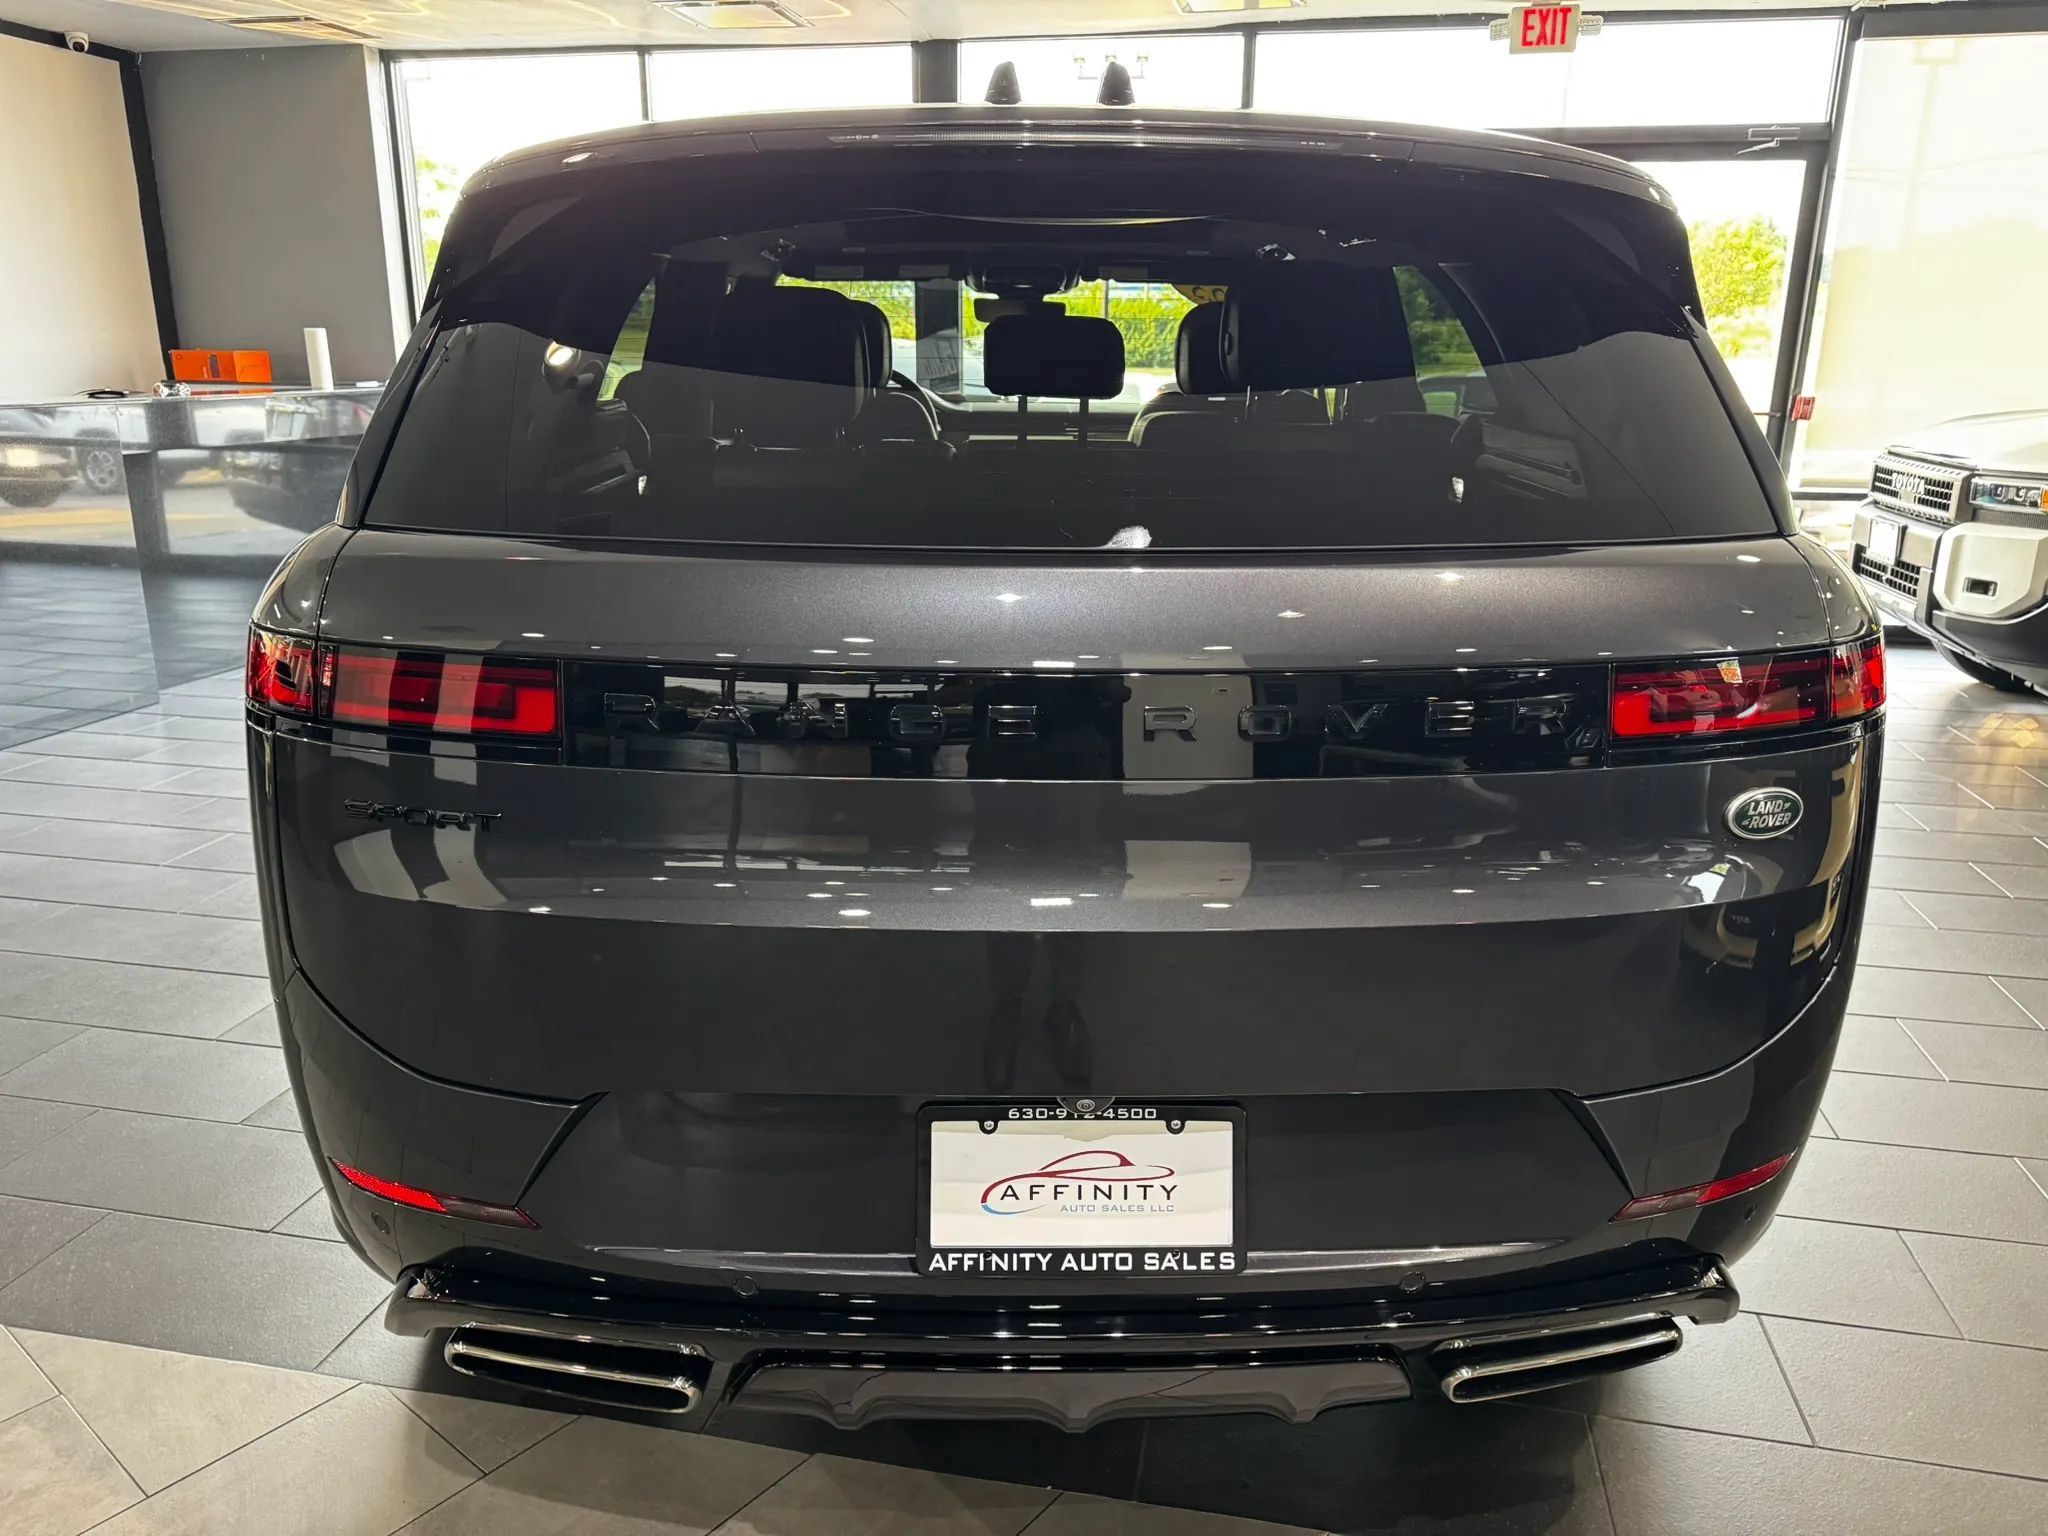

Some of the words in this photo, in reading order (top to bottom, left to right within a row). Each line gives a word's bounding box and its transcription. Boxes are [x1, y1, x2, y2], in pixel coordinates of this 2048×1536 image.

[1521, 7, 1572, 46] EXIT
[1891, 472, 1925, 495] TOYOTA
[603, 691, 1038, 740] RANGE
[1142, 698, 1569, 742] ROVER
[343, 799, 502, 832] SPORT
[1747, 799, 1784, 816] LAND
[1748, 812, 1792, 829] ROVER
[1000, 1184, 1178, 1201] AFFINITY
[1060, 1204, 1096, 1213] AUTO
[1101, 1204, 1145, 1213] SALES
[1150, 1204, 1175, 1213] LLC
[928, 1252, 1053, 1272] AFFINITY
[1060, 1252, 1133, 1272] AUTO
[1143, 1252, 1236, 1271] SALES
